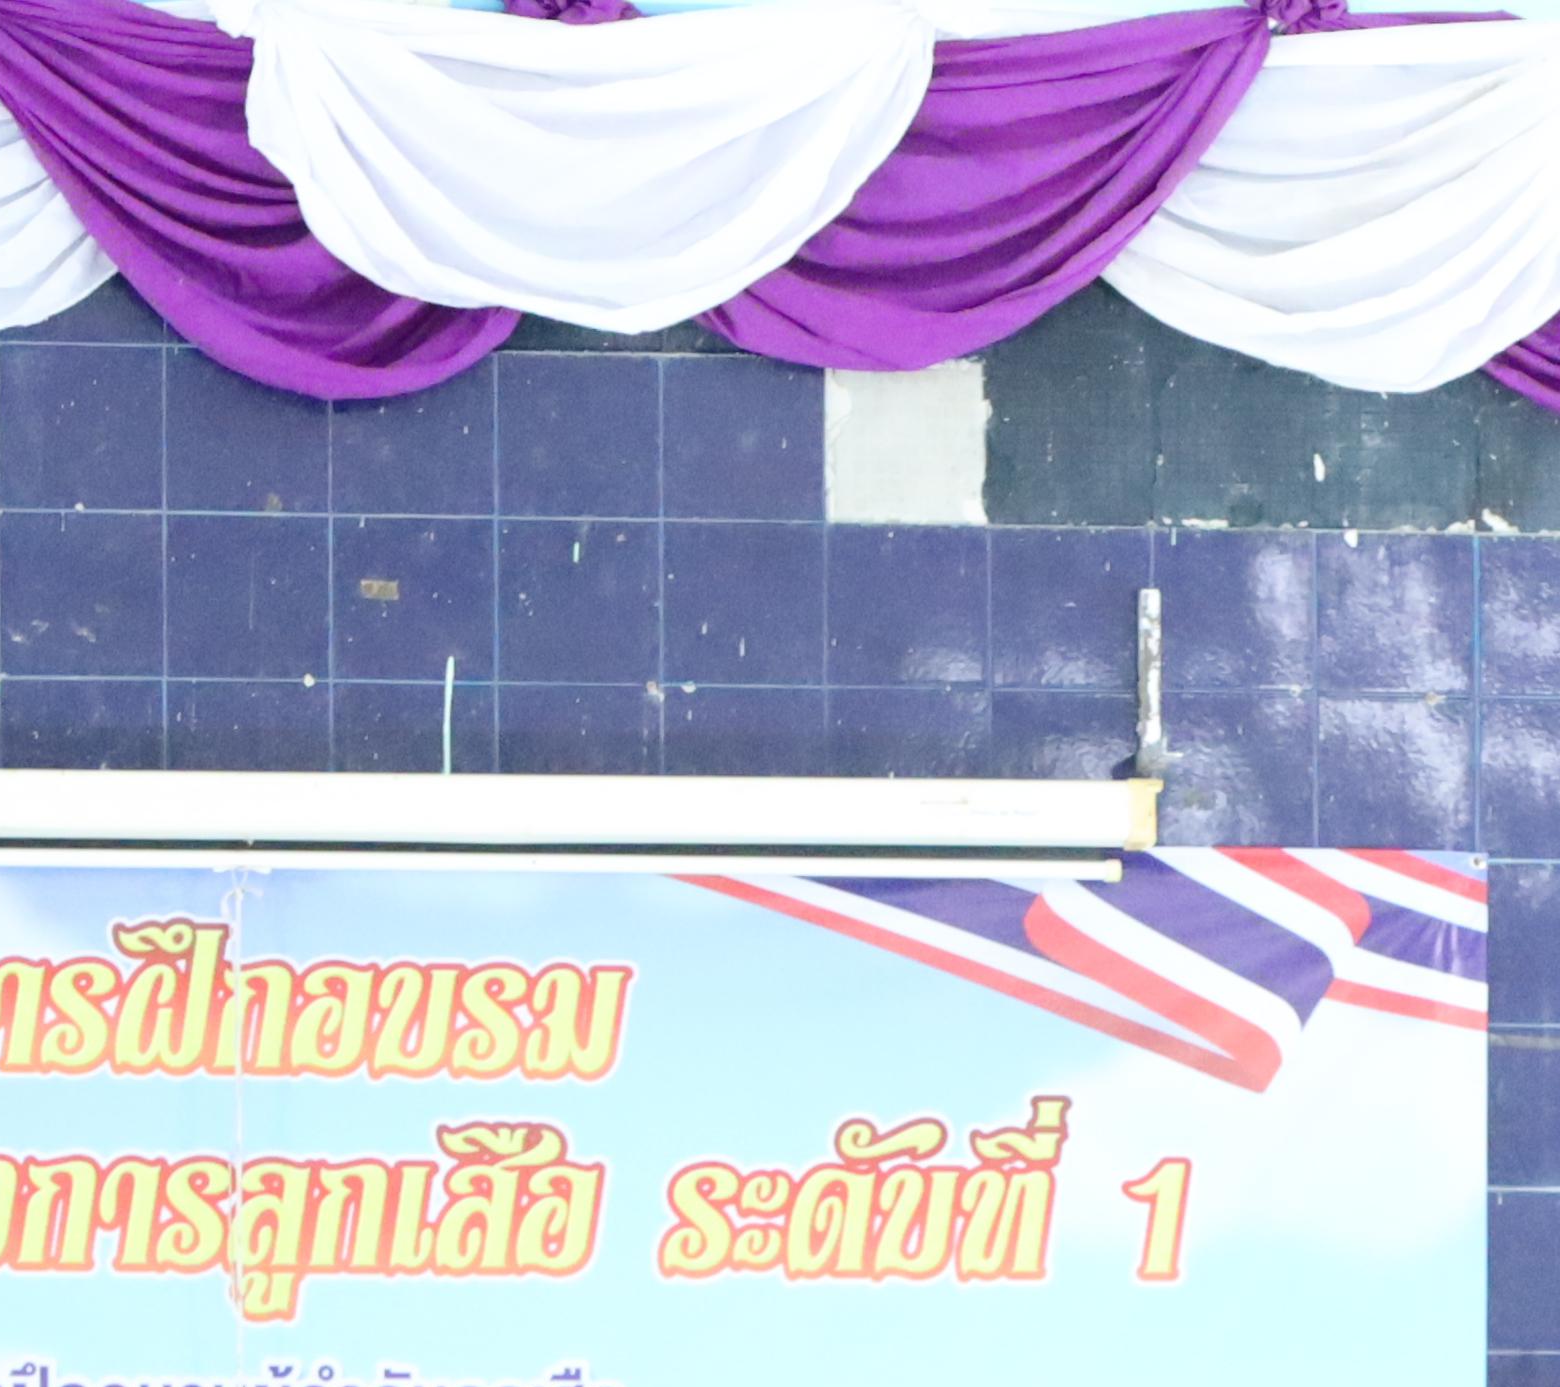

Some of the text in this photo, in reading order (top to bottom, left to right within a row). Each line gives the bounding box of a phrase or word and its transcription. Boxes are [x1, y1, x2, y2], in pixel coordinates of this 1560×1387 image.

[657, 1096, 1072, 1282] ระดับที่
[1122, 1157, 1192, 1282] 1
